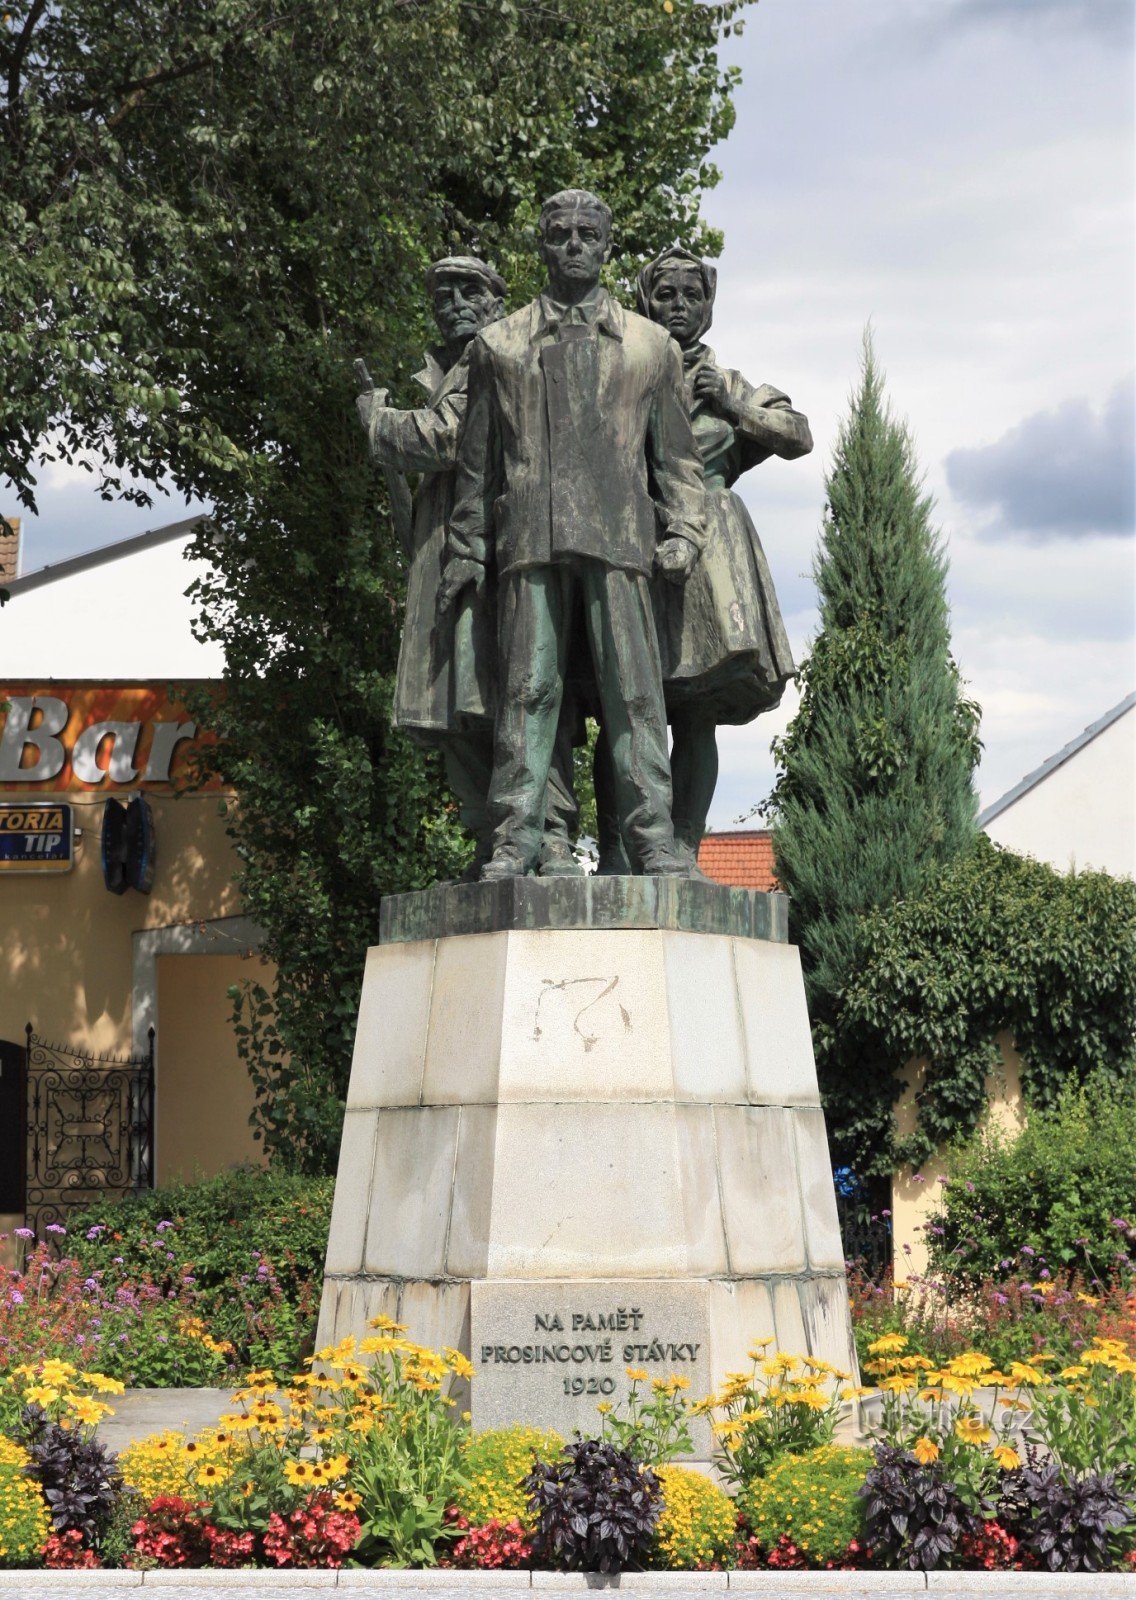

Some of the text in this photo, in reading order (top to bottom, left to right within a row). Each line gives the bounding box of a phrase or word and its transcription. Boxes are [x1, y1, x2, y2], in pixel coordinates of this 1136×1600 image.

[0, 696, 198, 783] Bar
[24, 834, 61, 852] TIP
[535, 1308, 643, 1331] NA PAMĚŤ
[481, 1338, 700, 1363] PROSINCOVÉ STÁVKY
[563, 1377, 616, 1396] 1920
